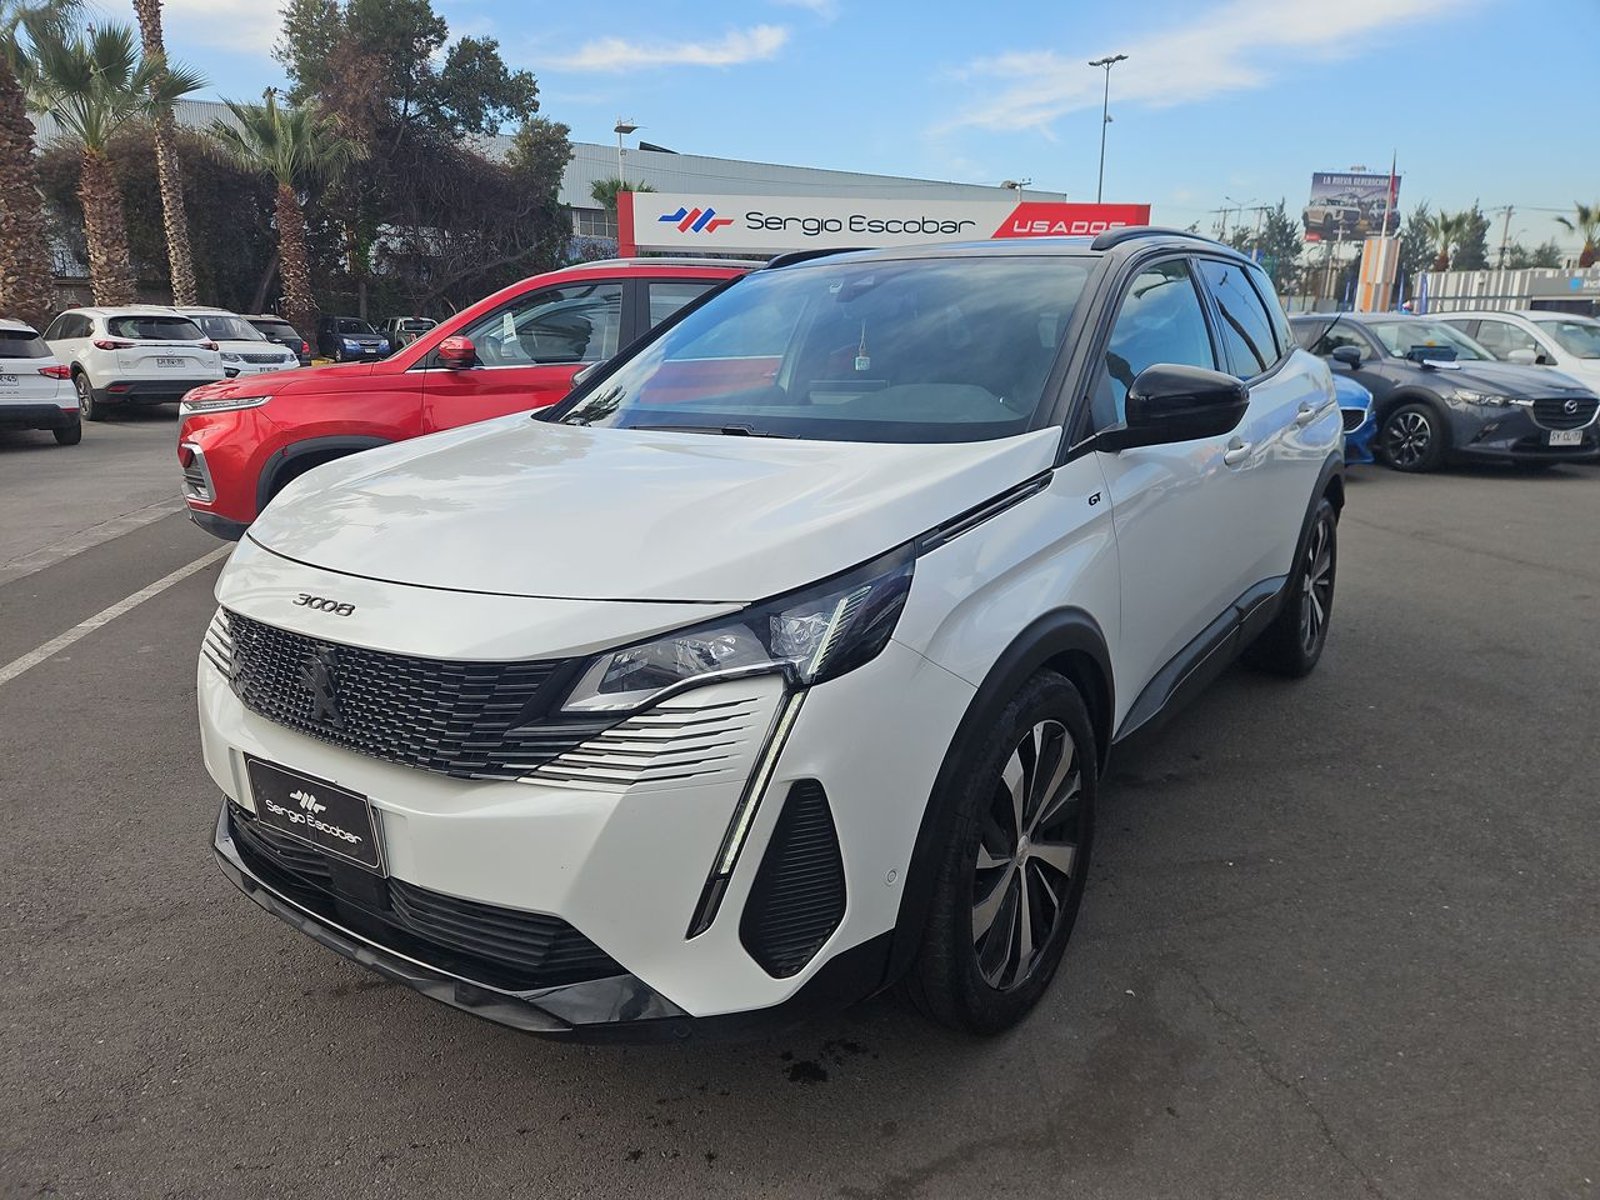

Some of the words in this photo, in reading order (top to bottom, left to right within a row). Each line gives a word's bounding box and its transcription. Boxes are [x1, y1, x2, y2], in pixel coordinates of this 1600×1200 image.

[745, 211, 842, 236] Sergio
[849, 215, 976, 234] Escobar
[1088, 491, 1101, 506] GT
[292, 592, 355, 617] 3008
[306, 813, 362, 844] Escobar
